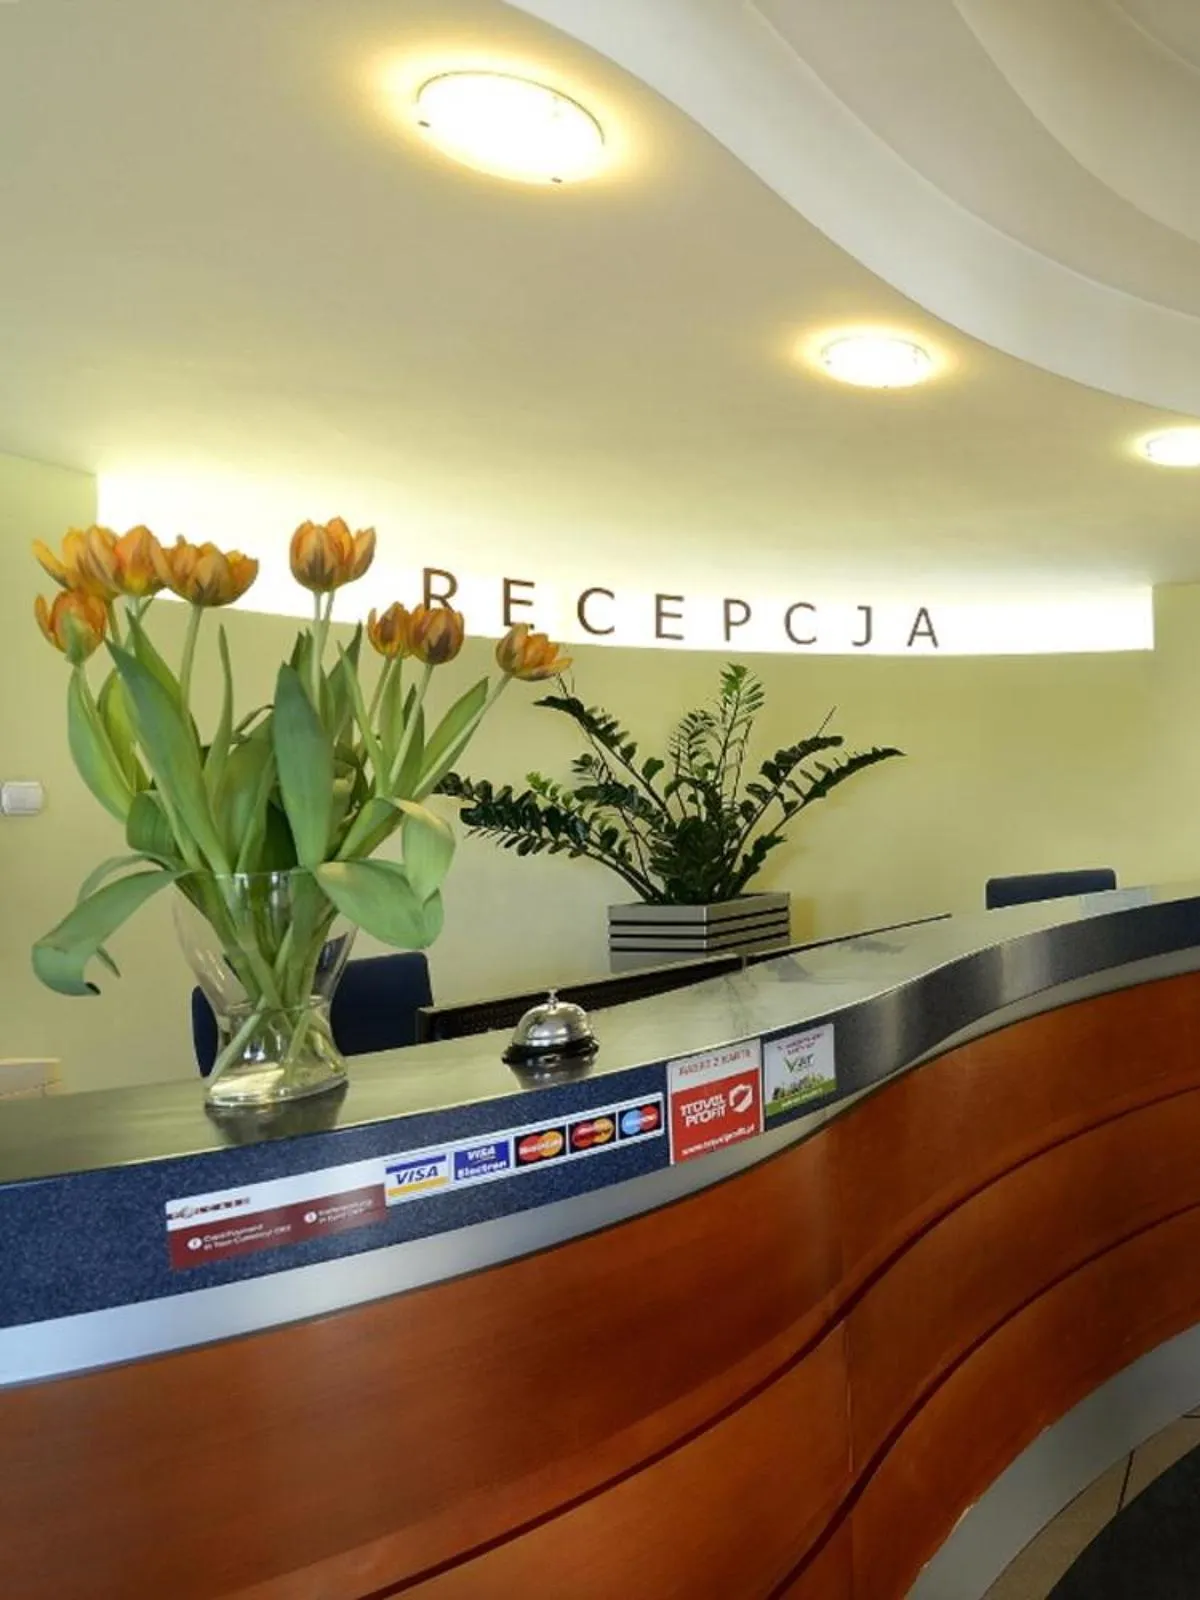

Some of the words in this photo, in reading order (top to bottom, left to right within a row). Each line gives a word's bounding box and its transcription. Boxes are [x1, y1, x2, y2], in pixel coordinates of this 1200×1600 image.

[423, 567, 939, 648] RECEPCJA
[467, 1145, 497, 1161] VISA
[395, 1165, 440, 1185] VISA
[457, 1160, 507, 1179] Electron
